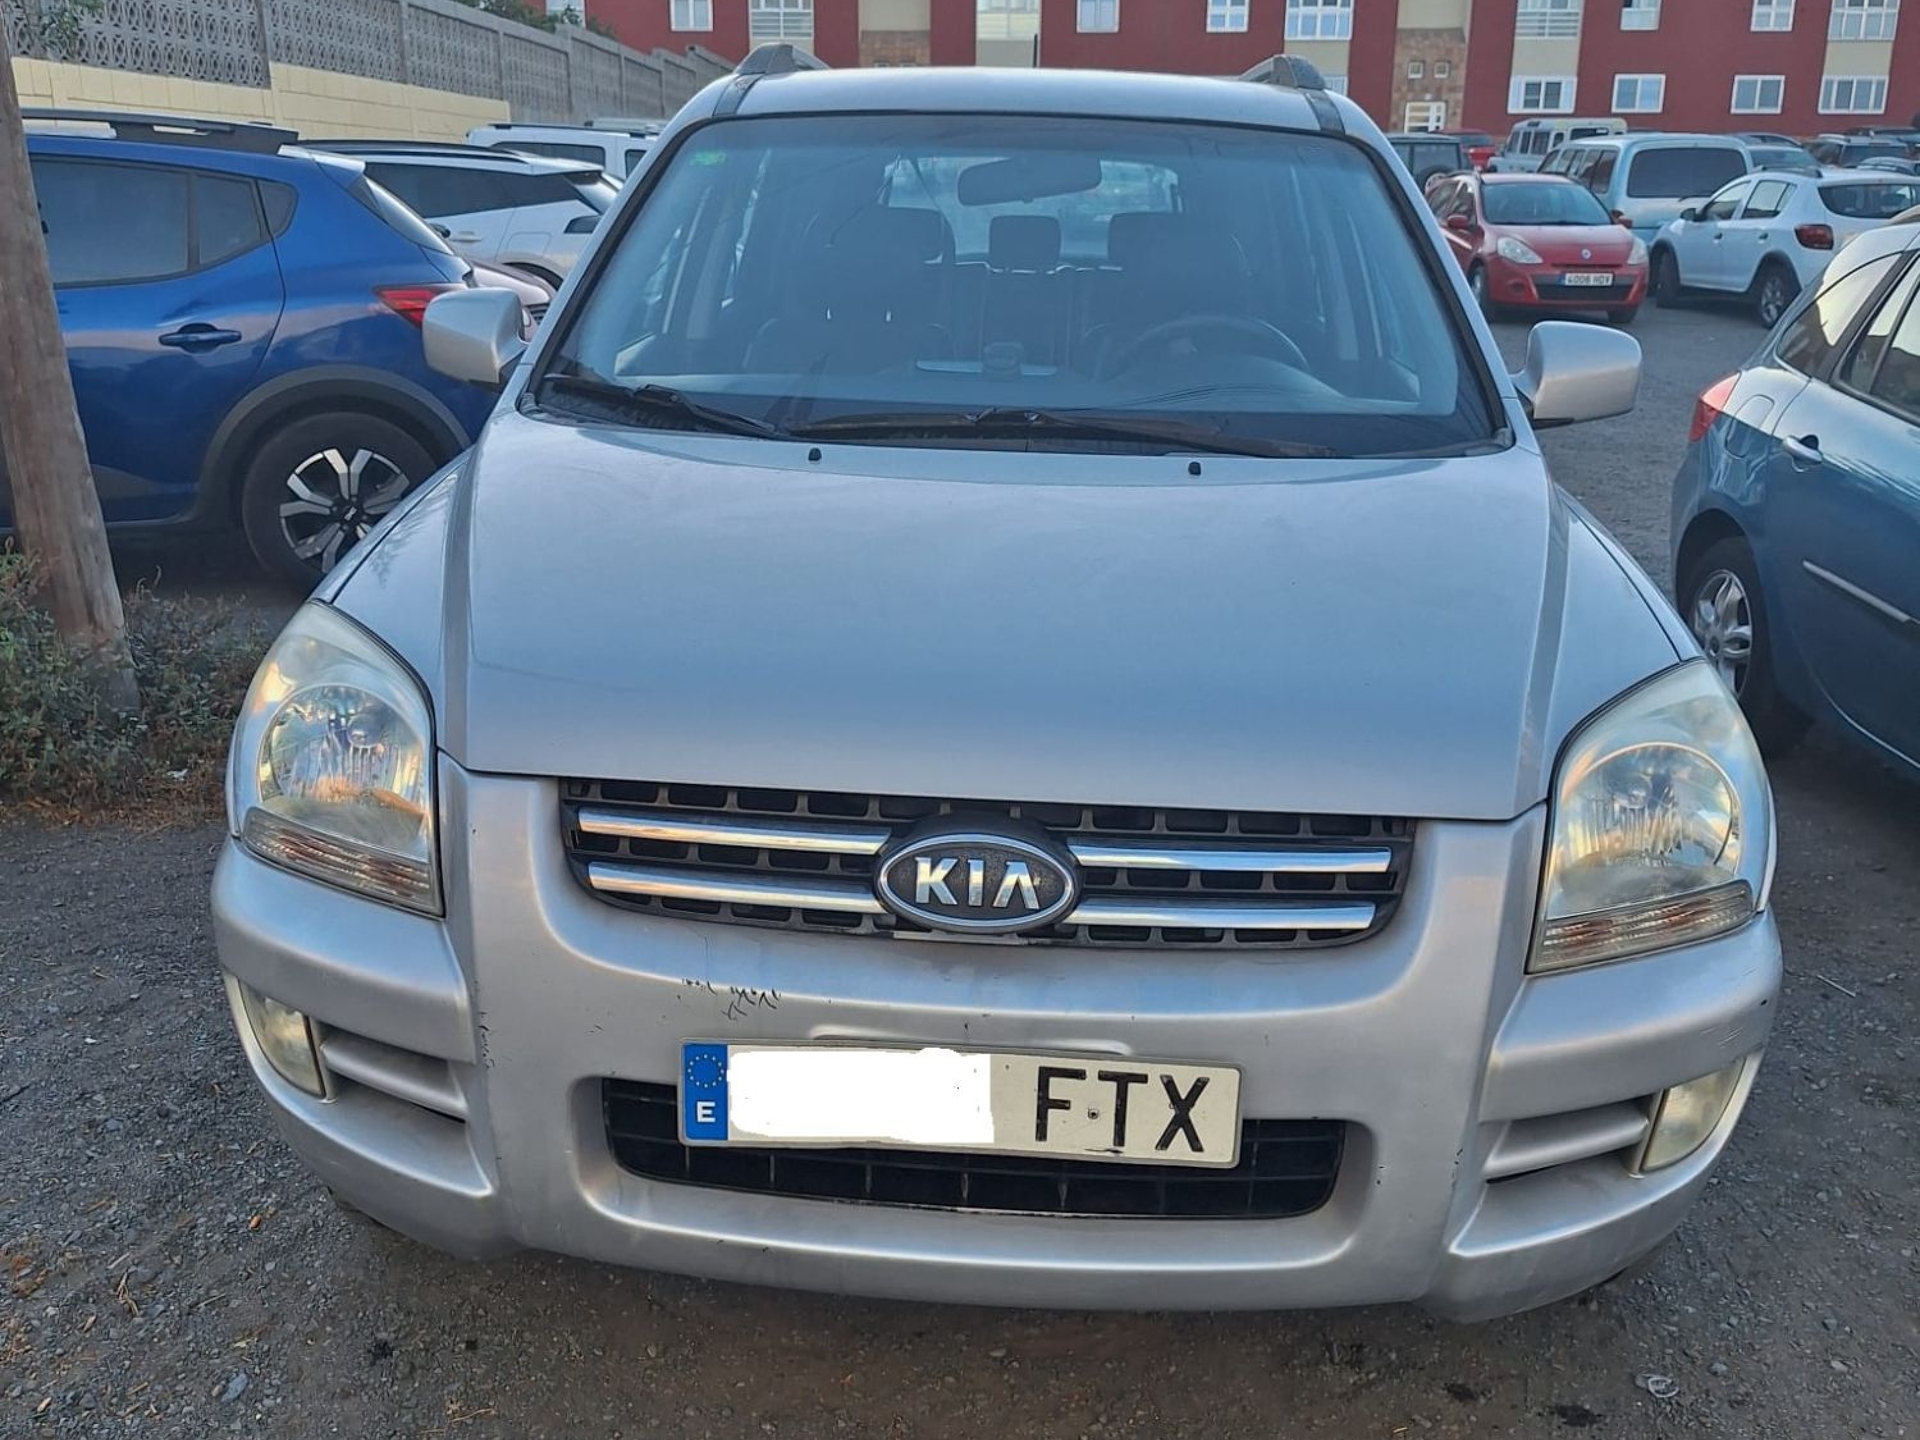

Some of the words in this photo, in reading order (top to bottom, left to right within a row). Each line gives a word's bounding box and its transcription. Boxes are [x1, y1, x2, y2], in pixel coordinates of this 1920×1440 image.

[914, 856, 1040, 910] KIA
[696, 1101, 716, 1122] E
[1035, 1066, 1210, 1153] FTX
